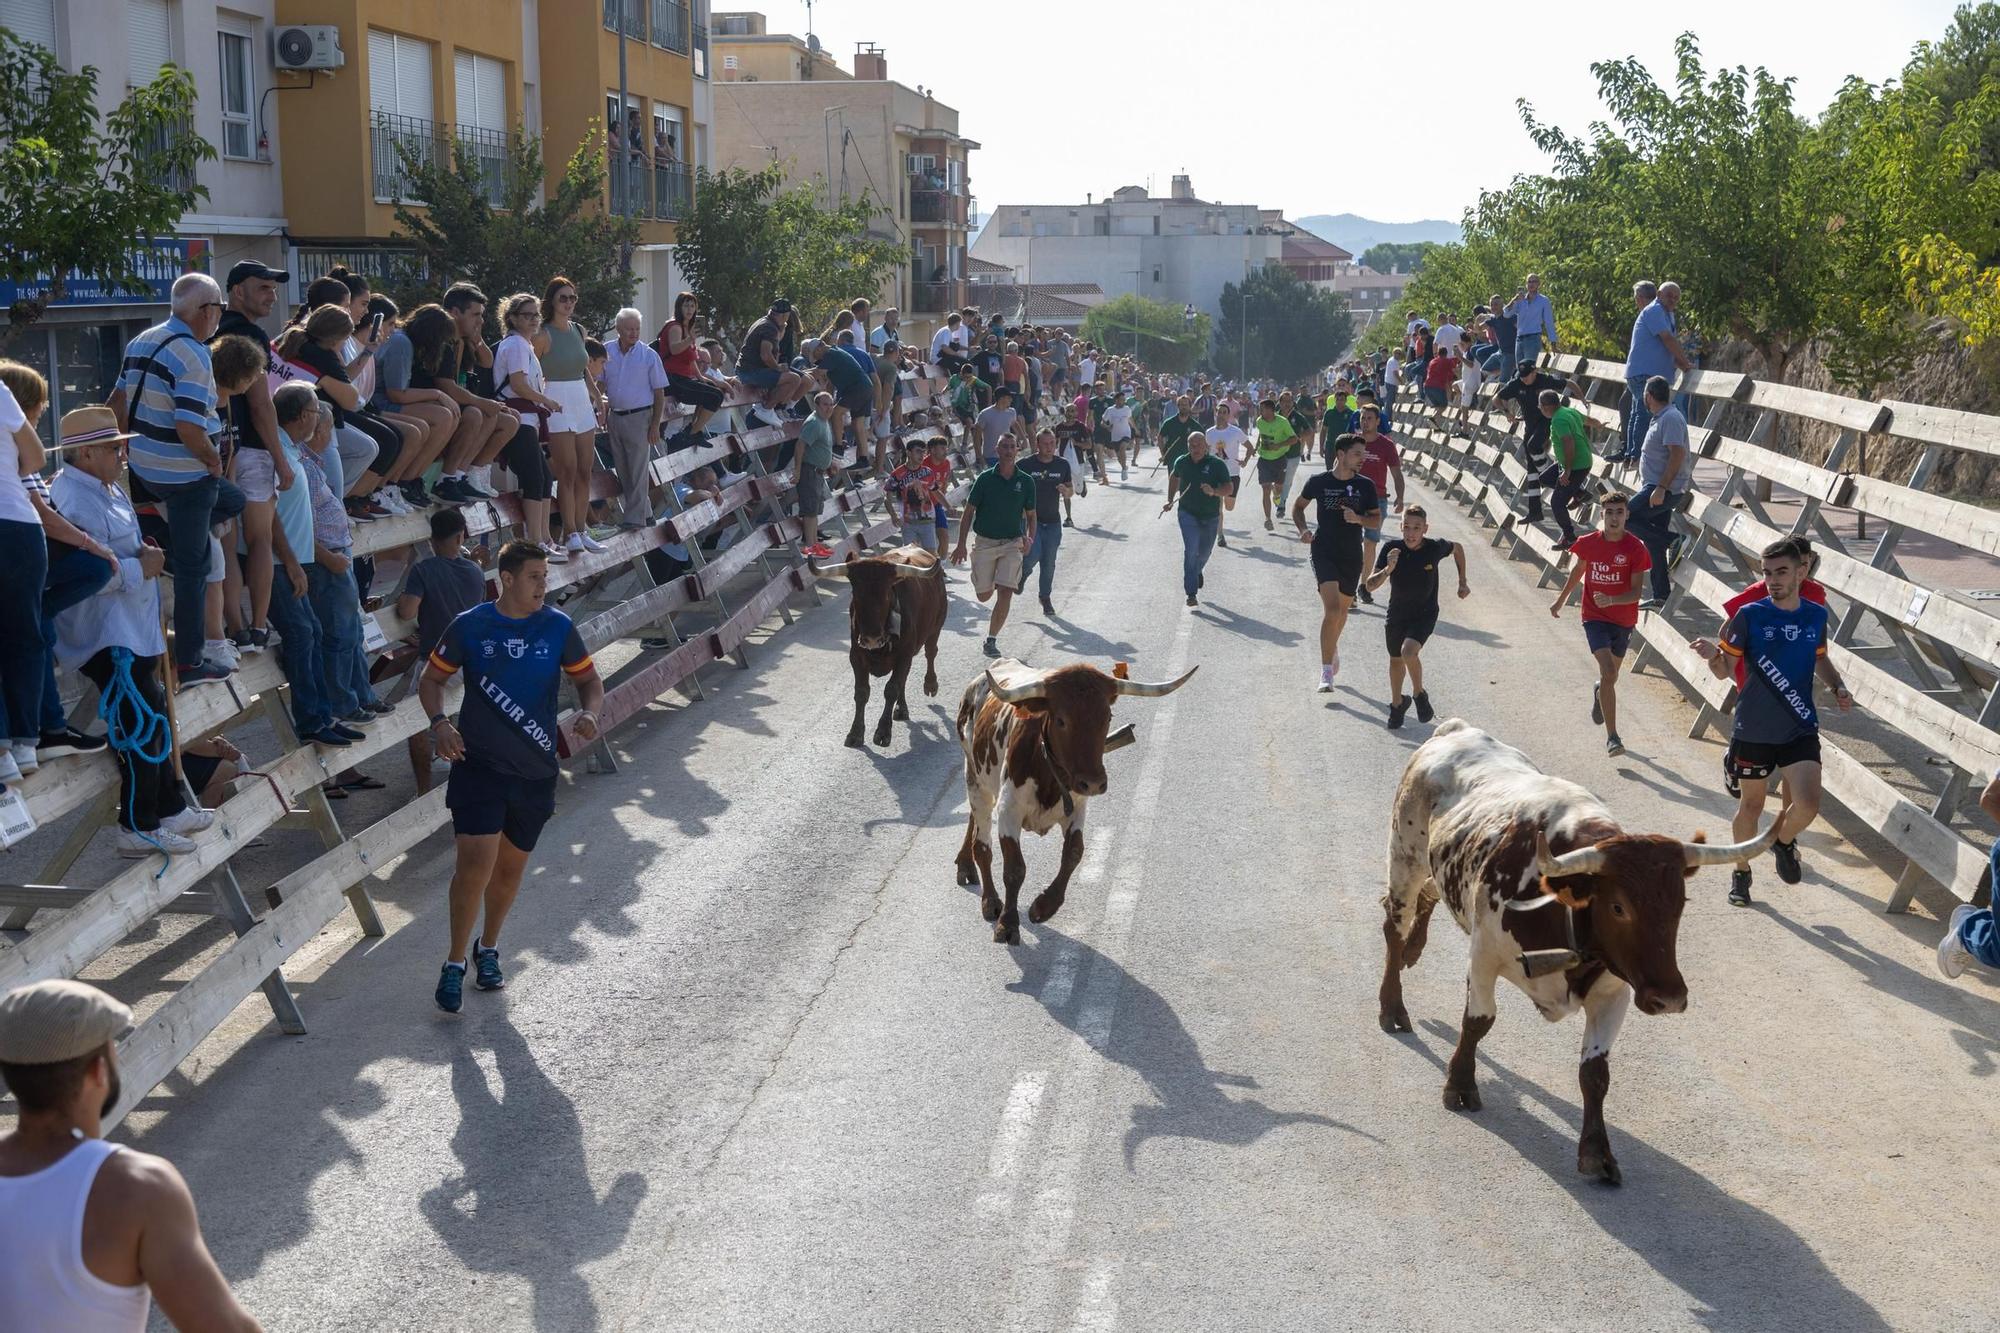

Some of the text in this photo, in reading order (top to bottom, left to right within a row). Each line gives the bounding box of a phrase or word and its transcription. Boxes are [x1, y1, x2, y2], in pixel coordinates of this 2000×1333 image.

[1590, 561, 1610, 572] Tío
[1591, 571, 1620, 582] Resti
[480, 675, 525, 723] LETUR
[1757, 654, 1811, 720] LETUR 2023
